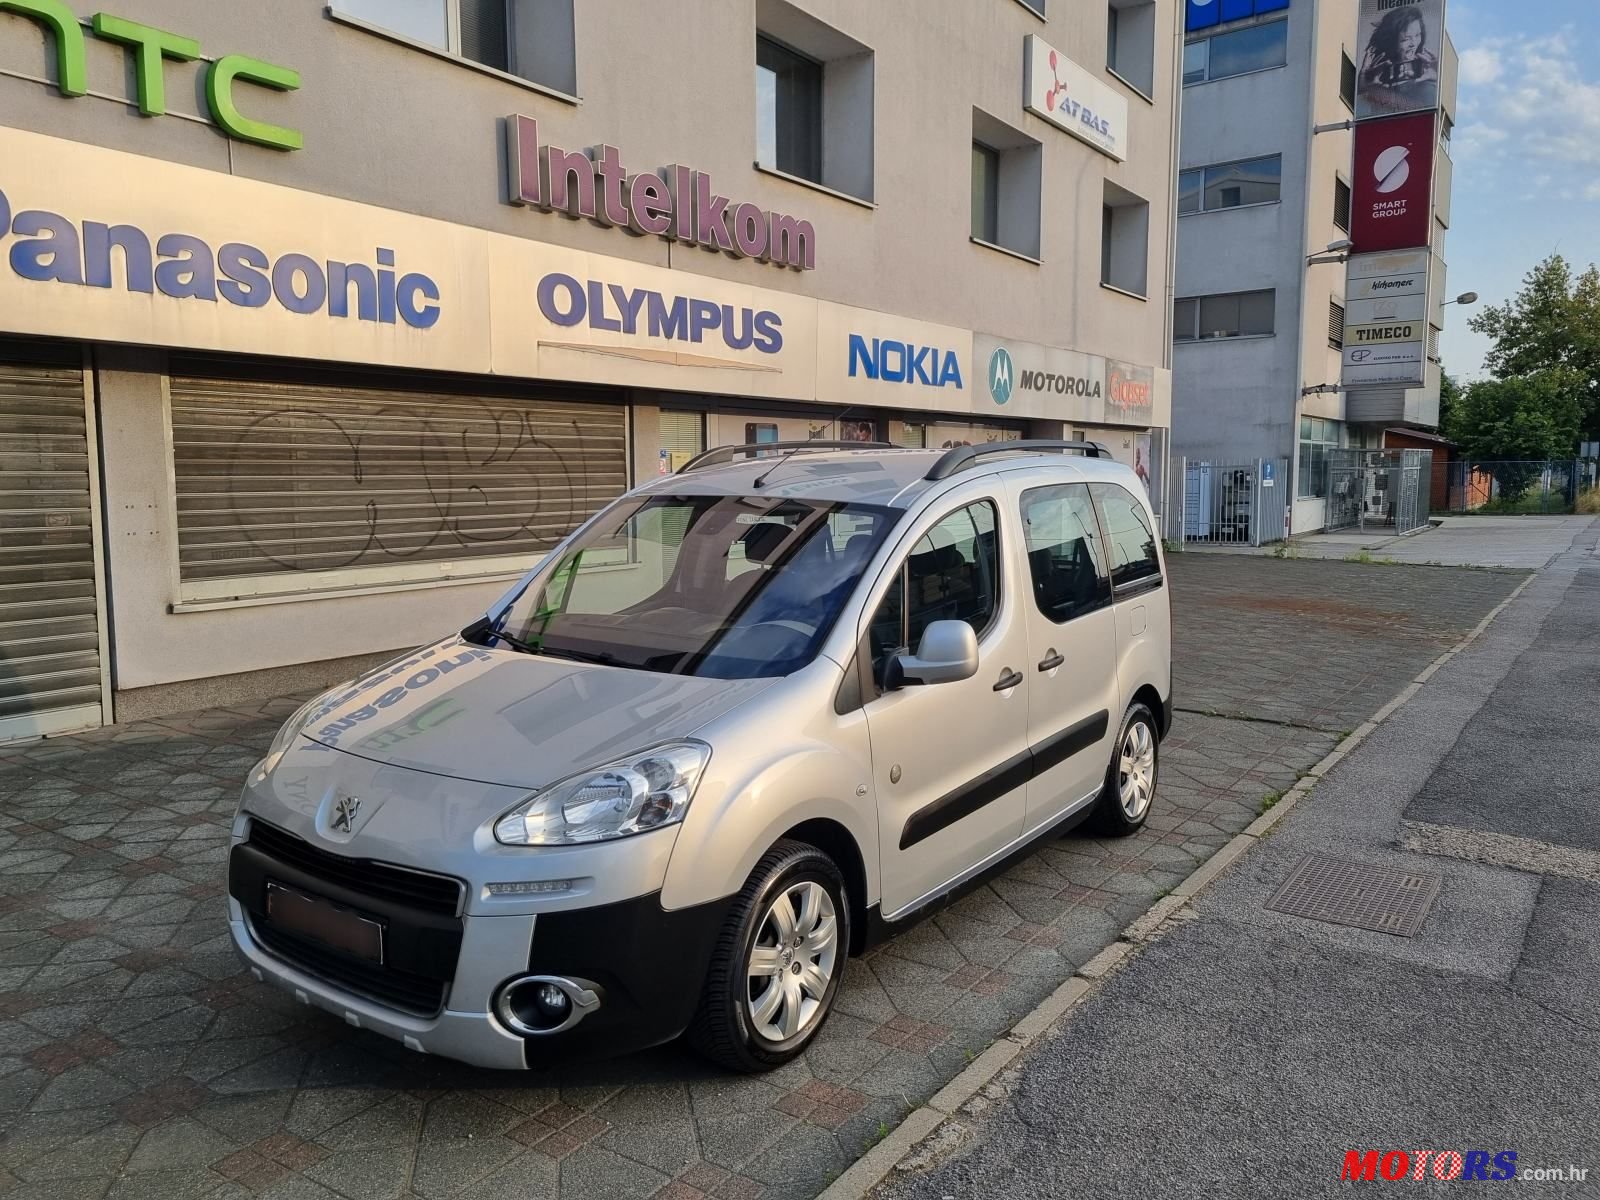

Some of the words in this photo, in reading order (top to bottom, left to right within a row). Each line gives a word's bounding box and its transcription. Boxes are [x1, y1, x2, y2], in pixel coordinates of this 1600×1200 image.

[507, 113, 816, 271] Intelkom
[1372, 199, 1408, 212] SMART
[1372, 208, 1408, 219] GROUP
[0, 188, 441, 329] anasonic
[537, 272, 783, 354] OLYMPUS
[1356, 325, 1412, 341] TIMECO
[848, 333, 963, 389] NOKIA
[1020, 369, 1101, 398] MOTOROLA
